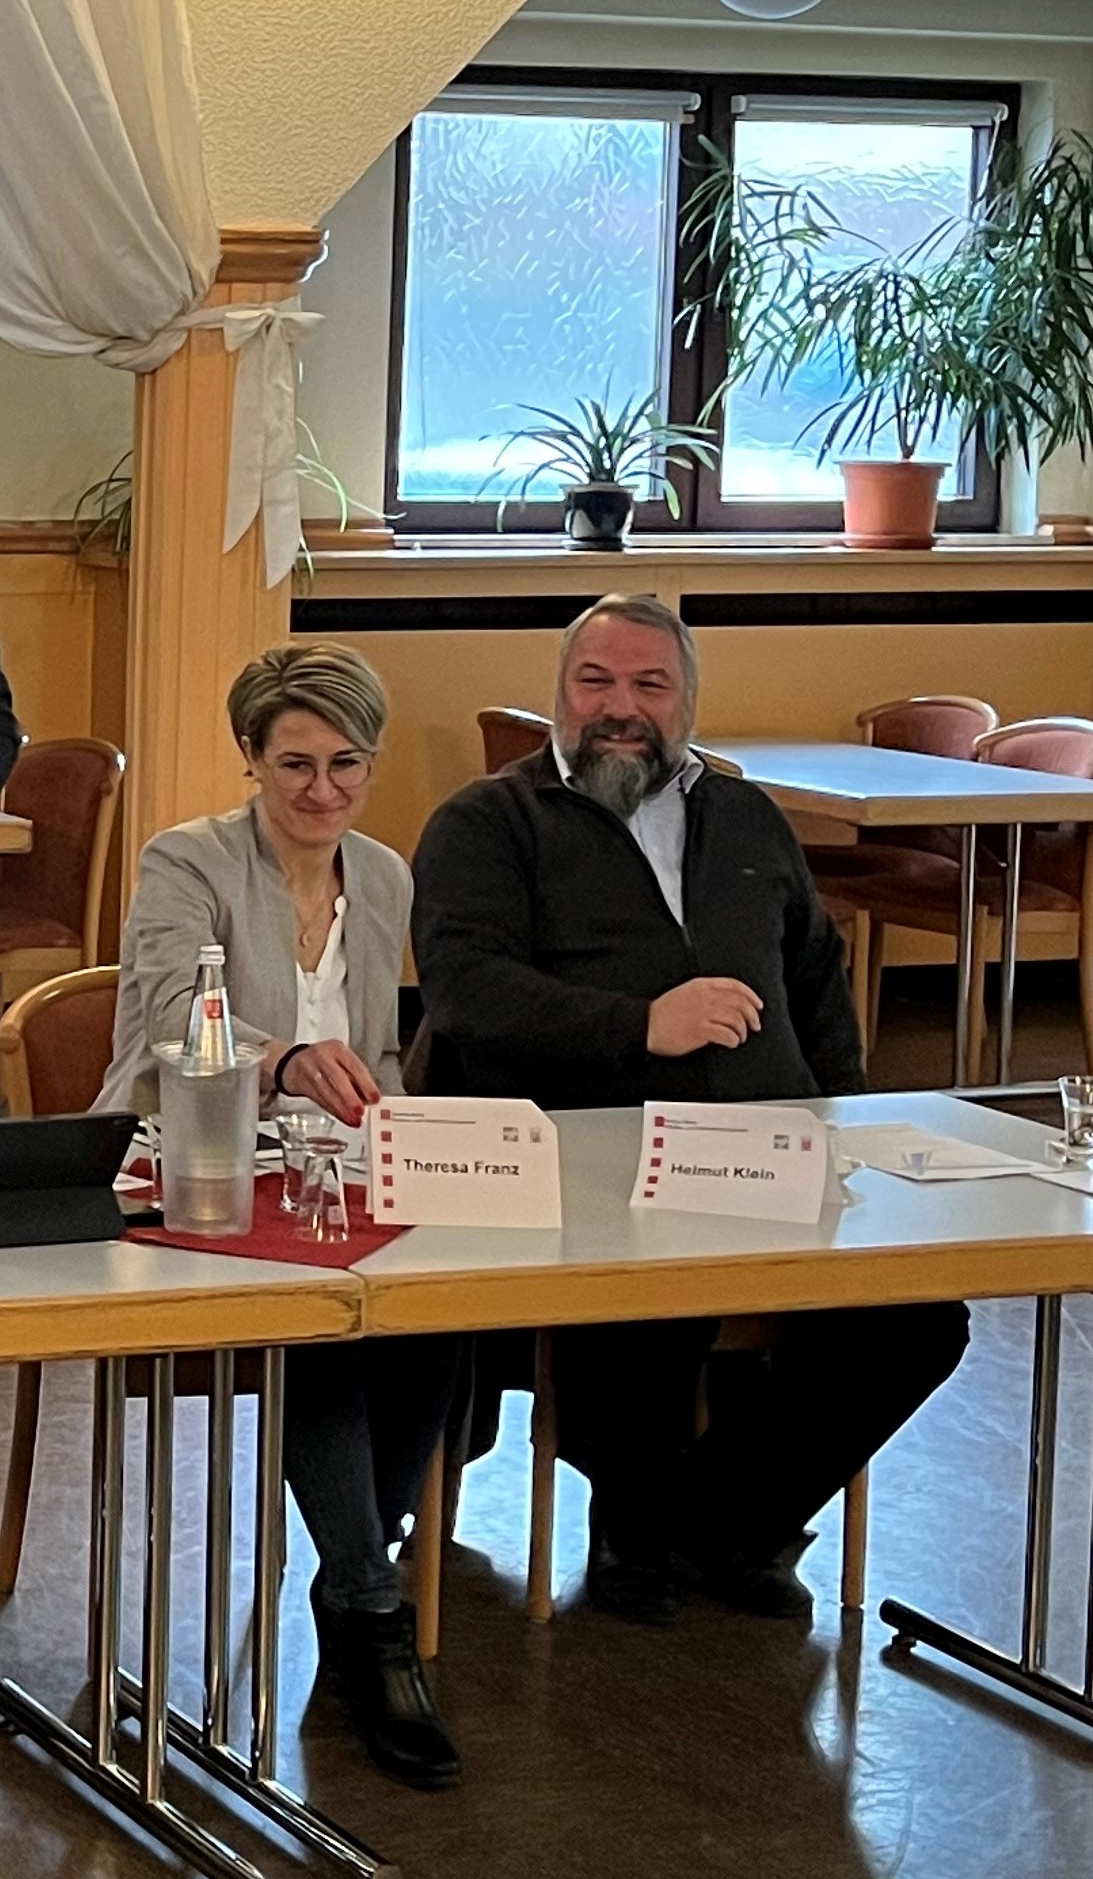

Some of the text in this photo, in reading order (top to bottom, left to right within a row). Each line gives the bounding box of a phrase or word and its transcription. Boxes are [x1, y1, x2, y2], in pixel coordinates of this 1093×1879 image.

[404, 1158, 520, 1176] Theresa Franz
[671, 1163, 775, 1181] Helmut Klein
